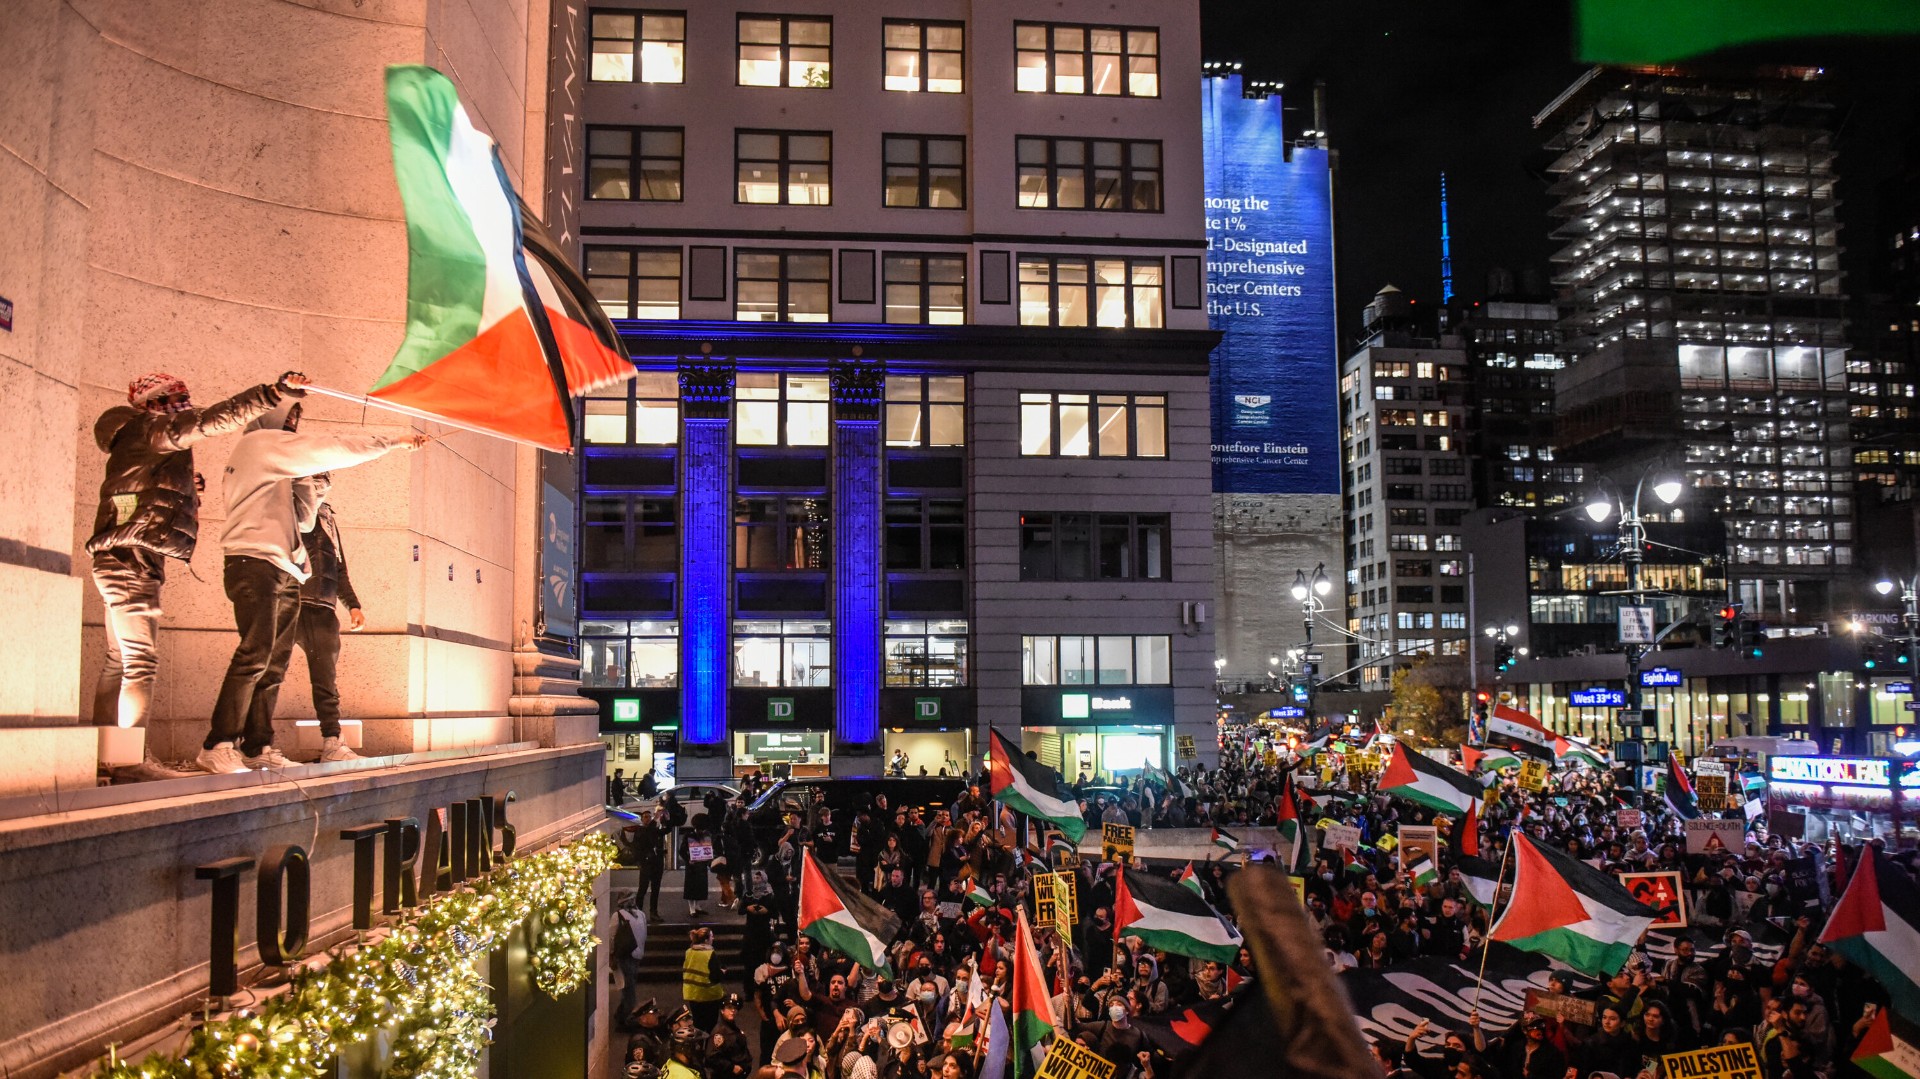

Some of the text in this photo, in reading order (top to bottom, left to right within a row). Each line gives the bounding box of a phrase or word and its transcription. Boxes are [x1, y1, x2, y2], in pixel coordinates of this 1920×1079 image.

[560, 4, 578, 247] YLVANIA
[1204, 195, 1269, 213] mong the
[1205, 216, 1246, 231] te 1%
[1207, 259, 1305, 277] mprehensive
[1207, 281, 1301, 296] ncer Centers
[1207, 301, 1265, 316] the U.S.
[1244, 396, 1261, 405] NCI
[1210, 441, 1308, 454] ontefiore Einstein
[1851, 613, 1899, 624] PARKING
[1643, 673, 1679, 685] Eighth Ave
[1091, 697, 1132, 710] Bank
[1573, 693, 1622, 704] West 33rd St
[615, 702, 639, 719] TD
[770, 702, 792, 717] TD
[917, 701, 939, 716] TD
[1105, 824, 1132, 839] FREE
[1103, 836, 1133, 846] PALESTINE
[339, 790, 517, 930] TRAINS
[1036, 873, 1074, 886] PALEINE
[195, 844, 311, 997] TO
[1052, 1038, 1112, 1079] PALESTINE
[1666, 1047, 1756, 1078] PALESTINE
